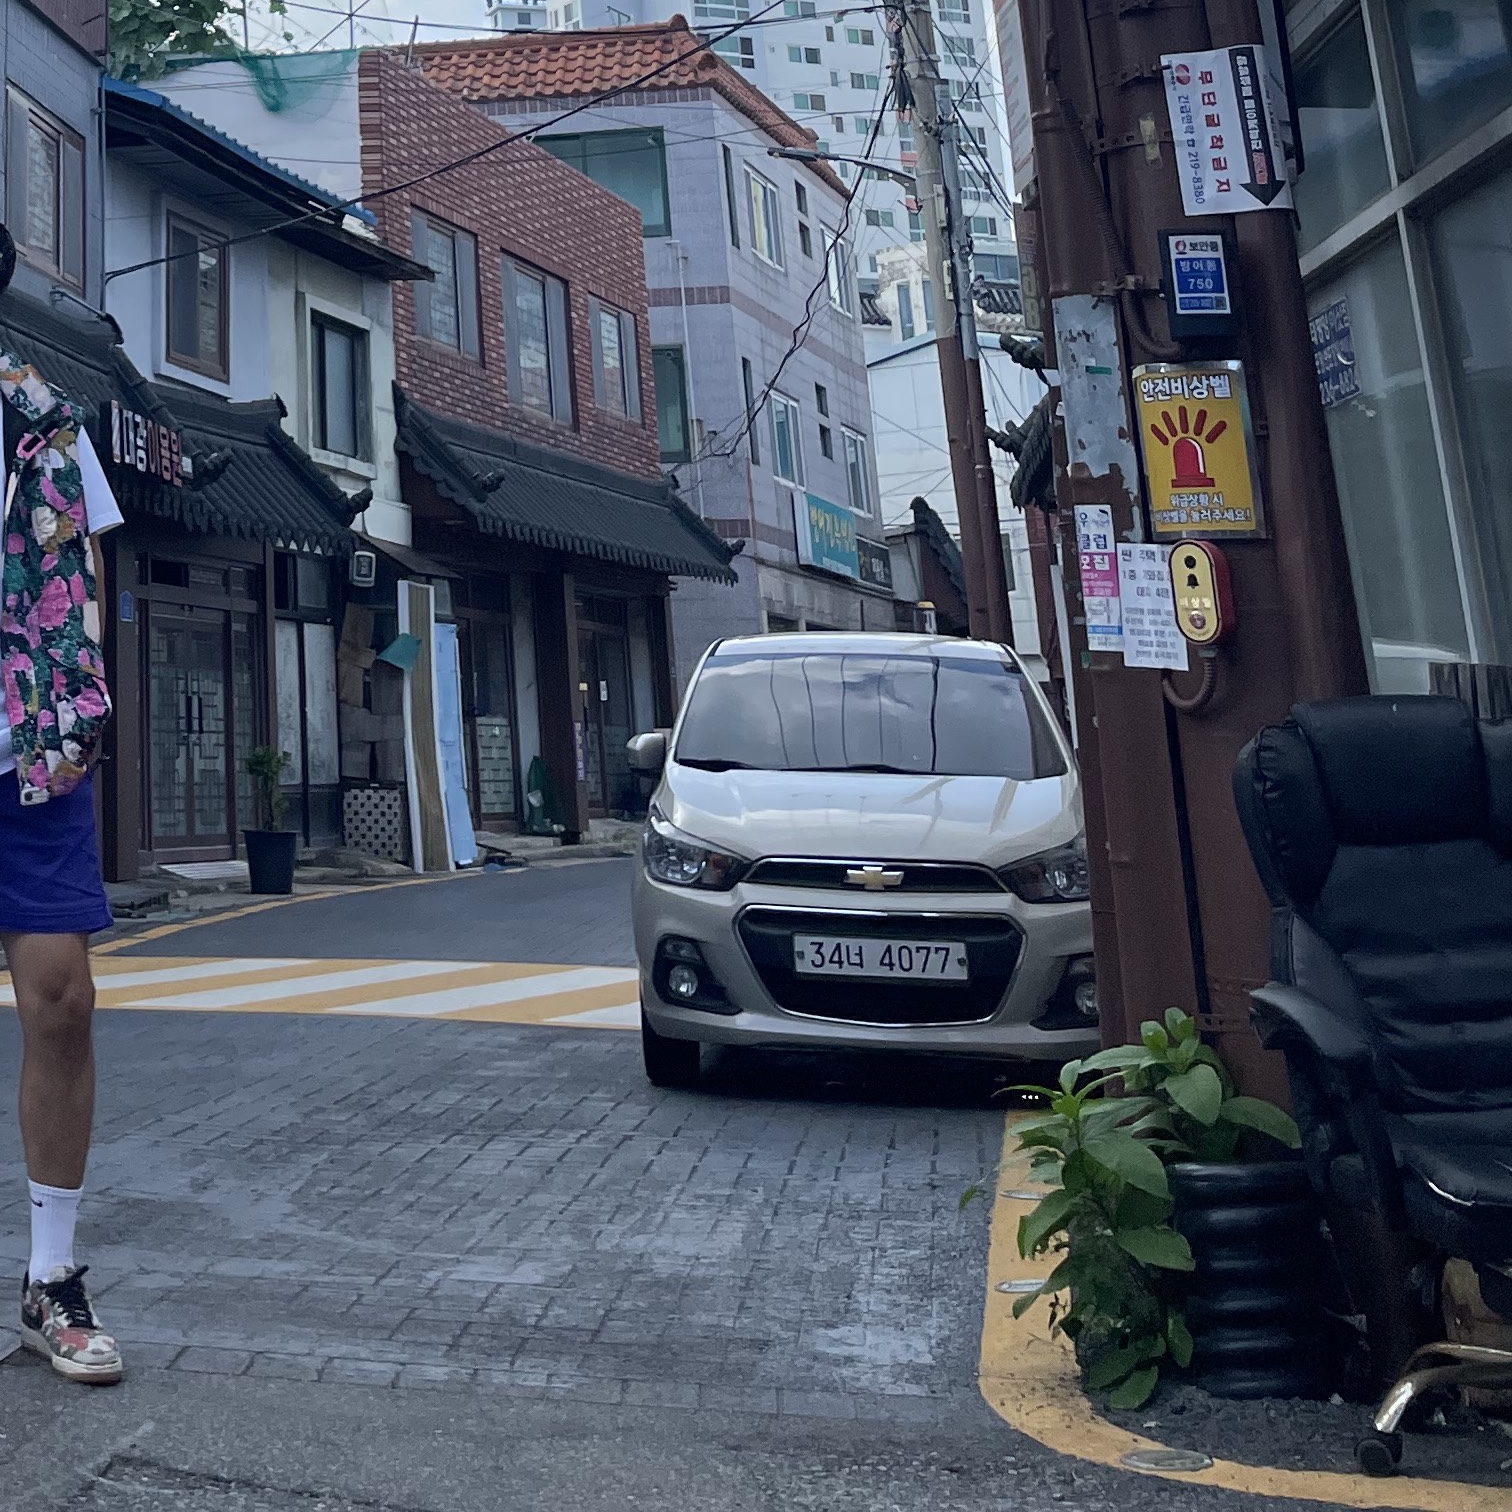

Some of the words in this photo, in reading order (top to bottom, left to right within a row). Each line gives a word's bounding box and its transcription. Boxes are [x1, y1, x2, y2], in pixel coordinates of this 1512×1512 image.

[1198, 70, 1231, 193] 무단굴착금지
[1177, 94, 1195, 135] 긴급연락
[1188, 151, 1206, 205] 219-8380
[1180, 259, 1217, 273] 방어동
[1188, 278, 1214, 290] 750
[1140, 374, 1232, 402] 안전비상벨
[1170, 492, 1209, 507] 위급상황
[1212, 493, 1224, 506] 시
[1190, 508, 1252, 523] 눌러주세요!
[809, 941, 864, 969] 34너
[879, 944, 951, 974] 4077
